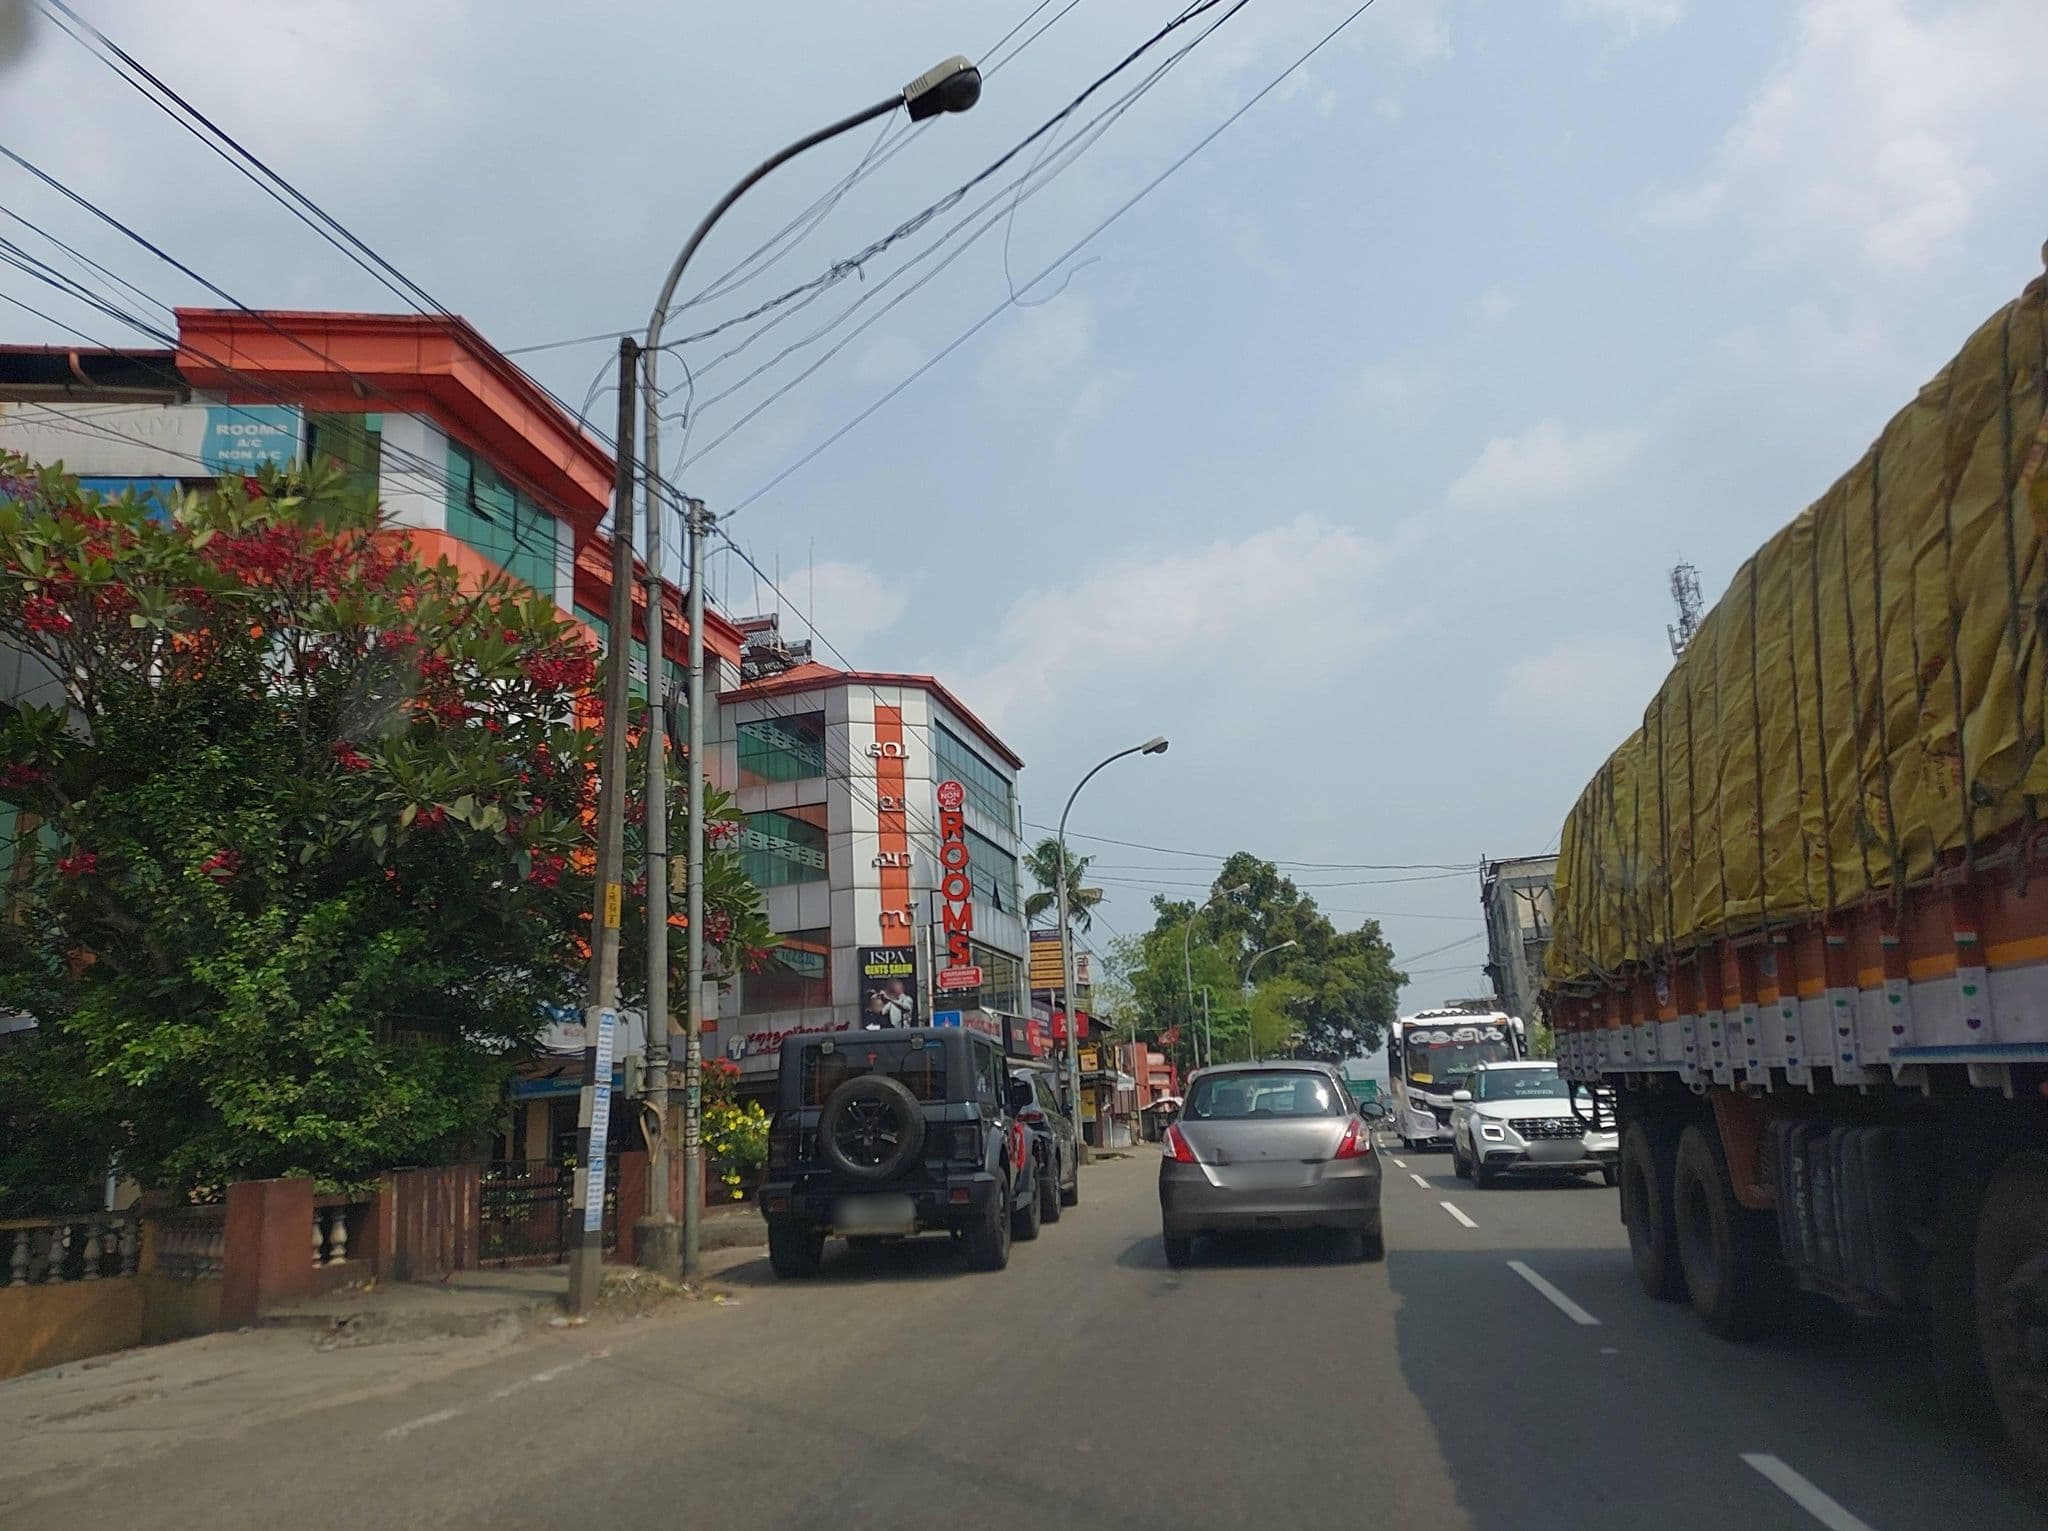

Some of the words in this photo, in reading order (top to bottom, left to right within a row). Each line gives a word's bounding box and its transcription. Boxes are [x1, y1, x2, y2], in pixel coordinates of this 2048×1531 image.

[216, 424, 288, 435] ROOMS
[237, 439, 263, 448] A/C
[218, 450, 252, 460] NON
[939, 811, 974, 965] ROOMS
[870, 950, 906, 964] ISPA
[865, 964, 888, 975] GENTS
[889, 963, 913, 974] SALON
